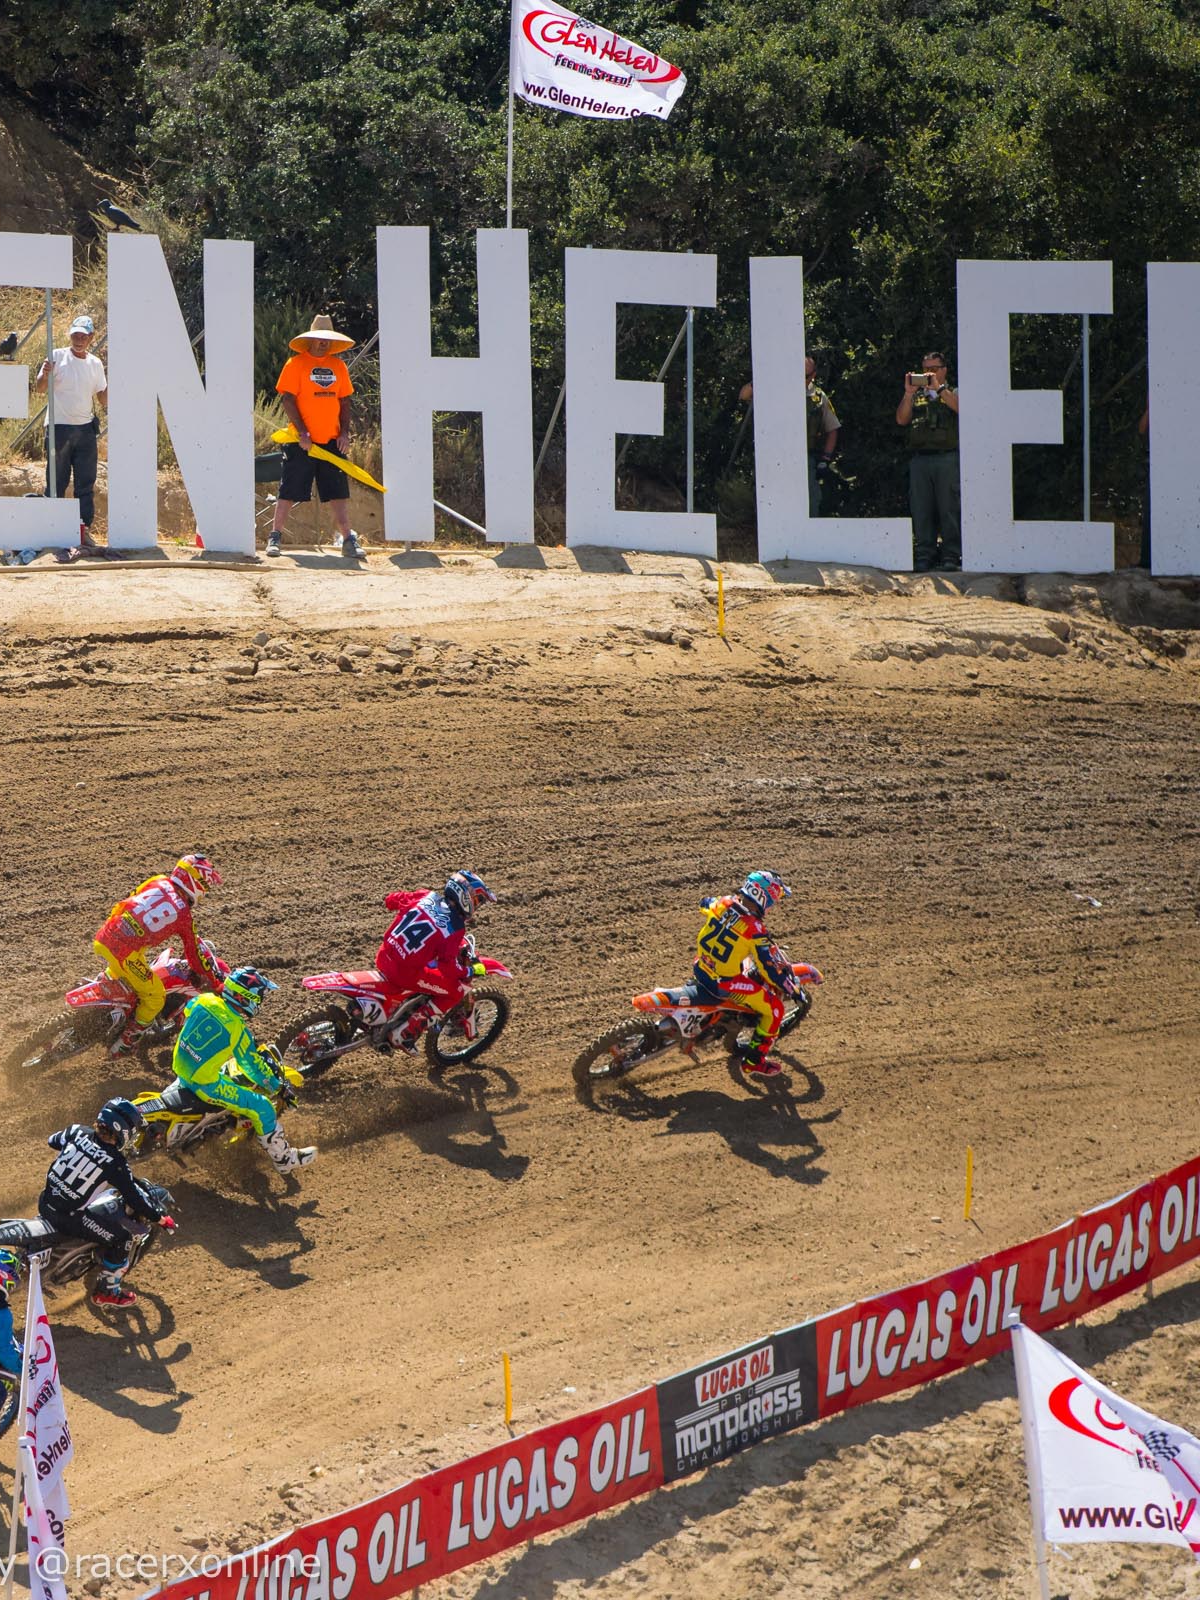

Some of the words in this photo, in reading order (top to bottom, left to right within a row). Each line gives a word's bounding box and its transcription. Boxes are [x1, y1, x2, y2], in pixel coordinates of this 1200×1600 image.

[131, 886, 178, 933] 48
[390, 906, 437, 954] 14
[699, 916, 740, 964] 25
[51, 1142, 104, 1196] 244
[74, 1129, 115, 1165] HOEFT
[1040, 1201, 1154, 1315] LUCAS
[1159, 1174, 1200, 1255] OI
[825, 1290, 957, 1398] LUCAS
[961, 1263, 1023, 1347] OIL
[700, 1359, 748, 1405] LUCAS
[749, 1346, 772, 1378] OIL
[719, 1387, 756, 1411] PRO
[674, 1381, 802, 1458] MOTOCROSS
[676, 1409, 804, 1472] CHAMPIONSHIP
[447, 1436, 579, 1553] LUCAS
[589, 1408, 651, 1494] OIL
[367, 1497, 427, 1585] OIL
